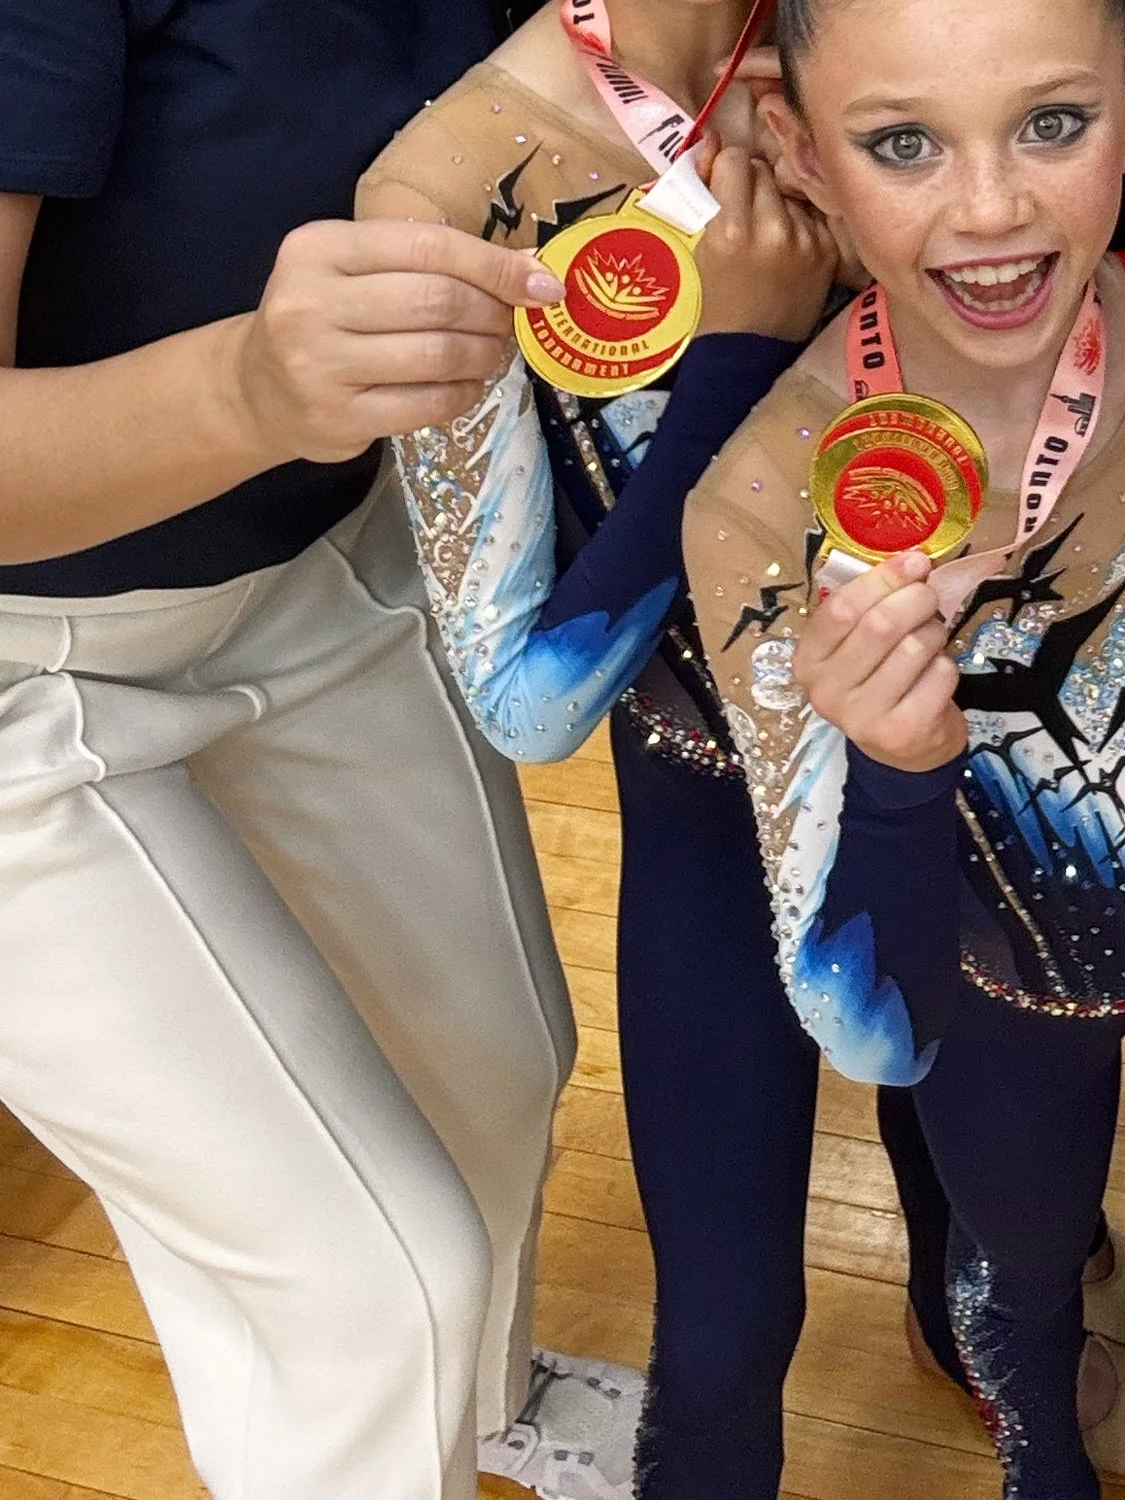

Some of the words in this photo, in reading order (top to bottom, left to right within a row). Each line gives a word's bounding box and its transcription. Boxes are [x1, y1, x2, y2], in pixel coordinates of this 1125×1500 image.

[532, 319, 630, 377] TOURNAMENT
[549, 301, 650, 357] NTERNATIONAL
[860, 291, 886, 370] ONTO
[1023, 435, 1069, 533] RONTO
